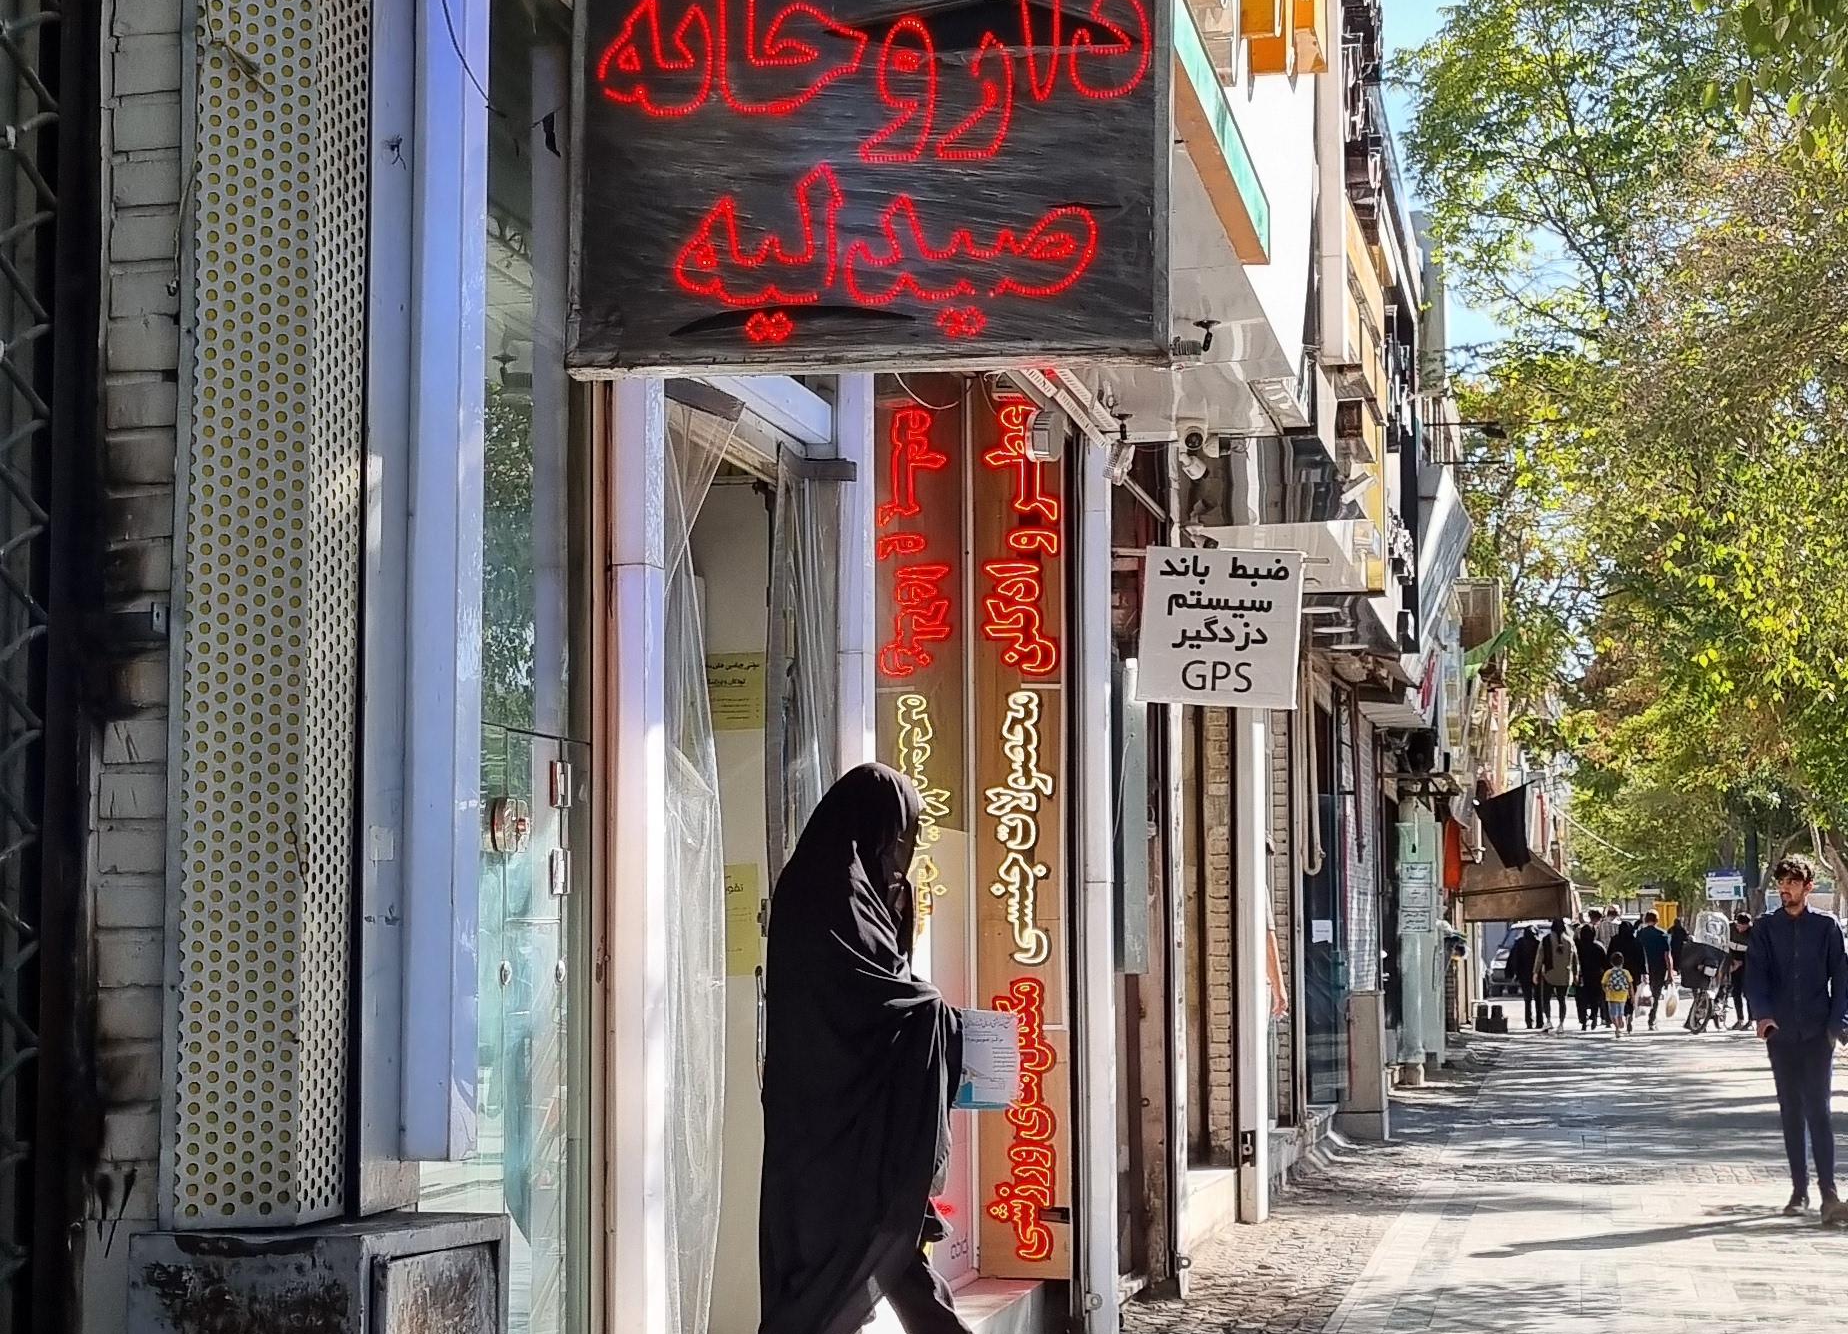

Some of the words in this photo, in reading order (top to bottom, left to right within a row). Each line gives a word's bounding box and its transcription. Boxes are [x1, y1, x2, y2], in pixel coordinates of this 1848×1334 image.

[1008, 529, 1058, 554] و
[1159, 554, 1211, 585] باند
[1228, 557, 1290, 588] ضبط
[984, 562, 1057, 673] ادکلن
[1166, 589, 1273, 619] سیستم
[1171, 615, 1269, 652] دزدگیر
[1181, 659, 1253, 693] GPS
[985, 690, 1054, 852] محصولات
[990, 852, 1050, 965] جنسی
[989, 1146, 1052, 1260] ورزشی
